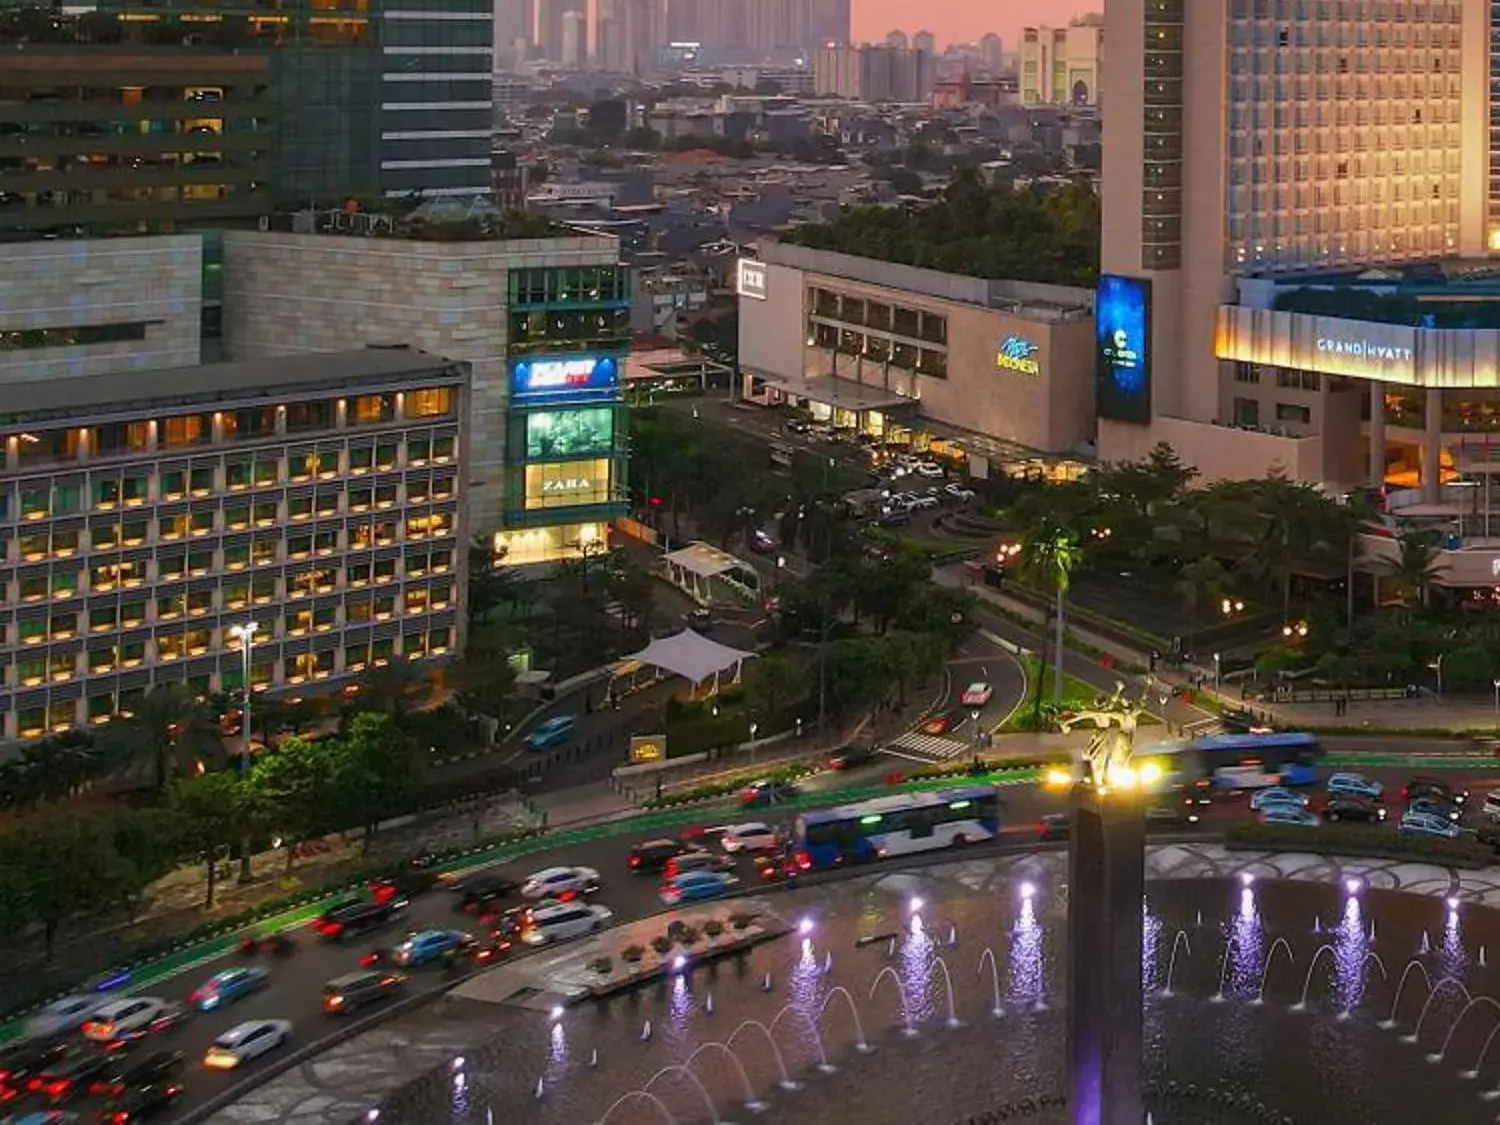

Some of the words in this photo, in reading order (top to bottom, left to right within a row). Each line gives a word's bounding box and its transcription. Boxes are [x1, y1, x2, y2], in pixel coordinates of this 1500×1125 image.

[1317, 338, 1361, 355] GRAND
[1367, 342, 1411, 361] HYATT
[543, 479, 590, 491] ZARA
